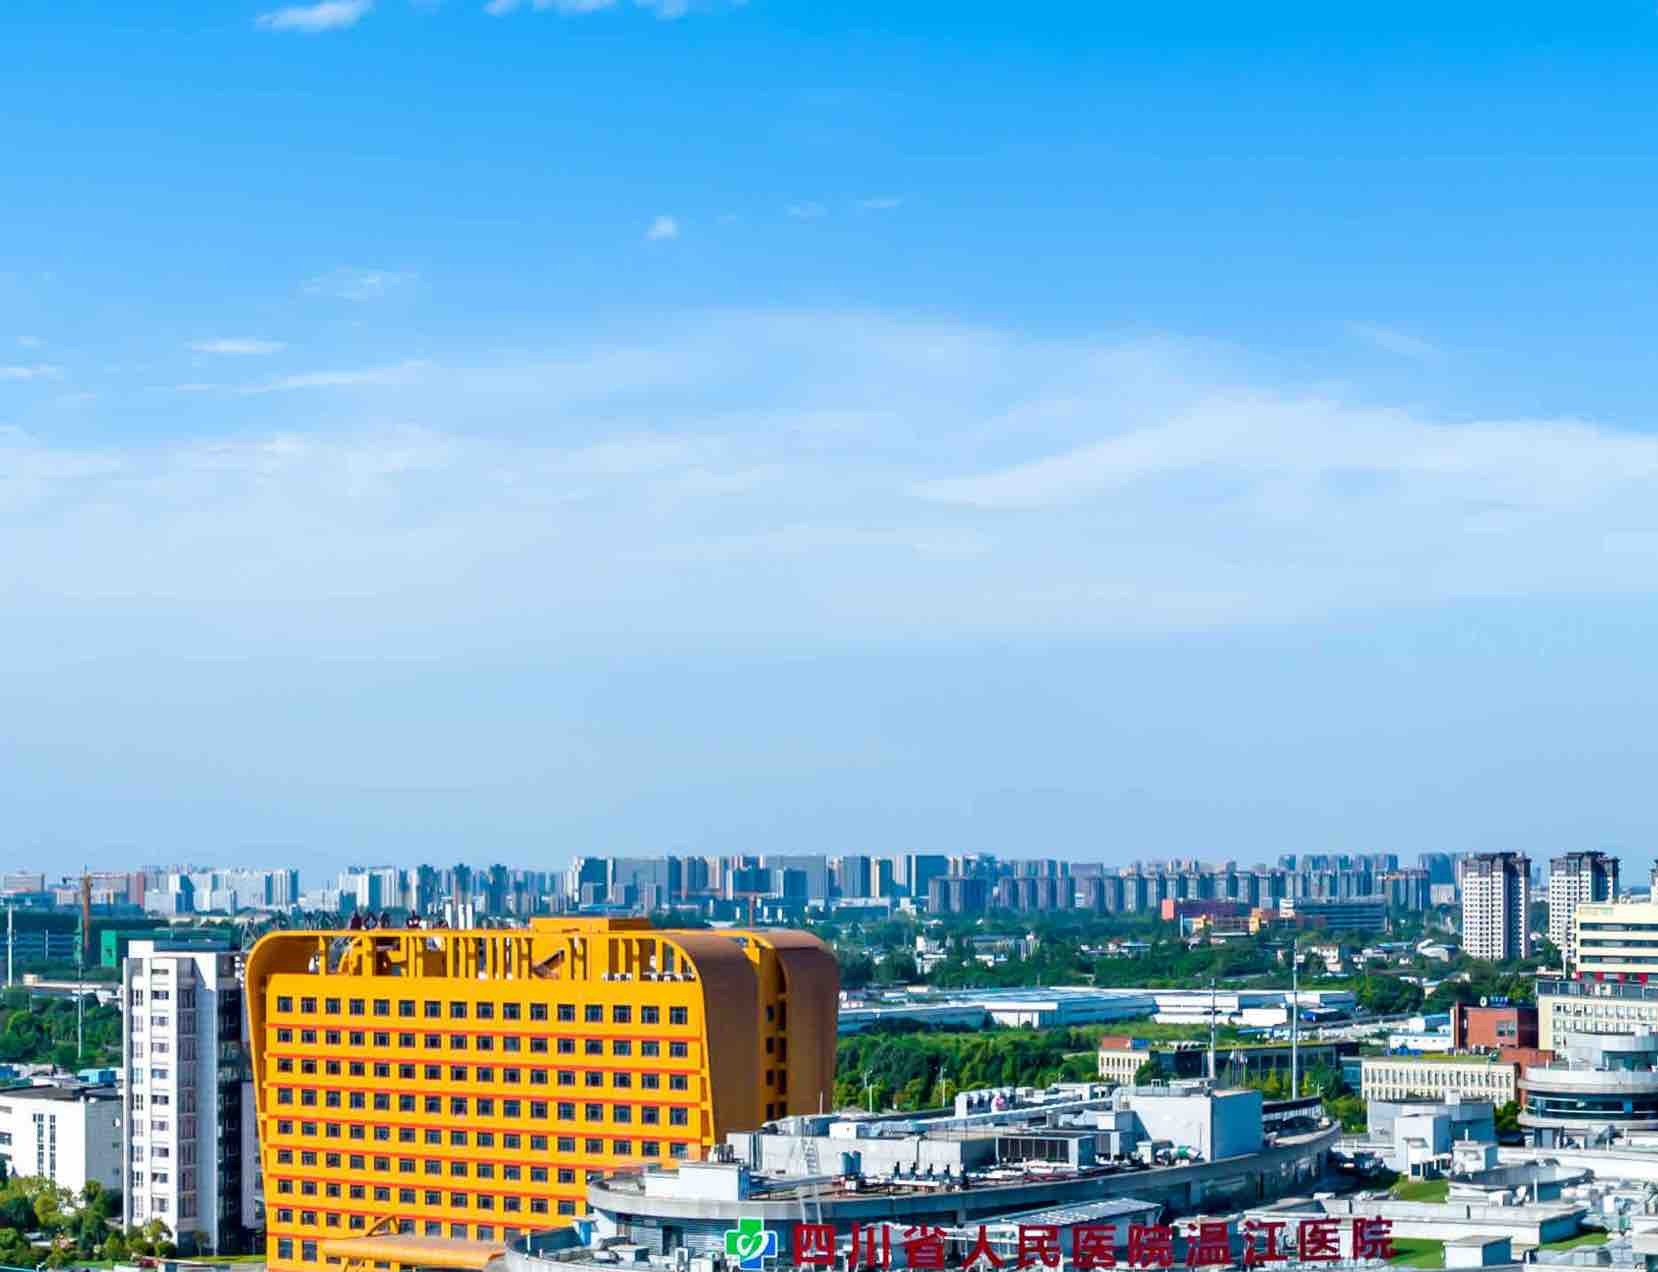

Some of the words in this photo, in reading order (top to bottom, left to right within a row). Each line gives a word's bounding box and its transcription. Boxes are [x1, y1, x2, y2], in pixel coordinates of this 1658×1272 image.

[792, 1216, 1396, 1270] 四川省人民医院温江医院
